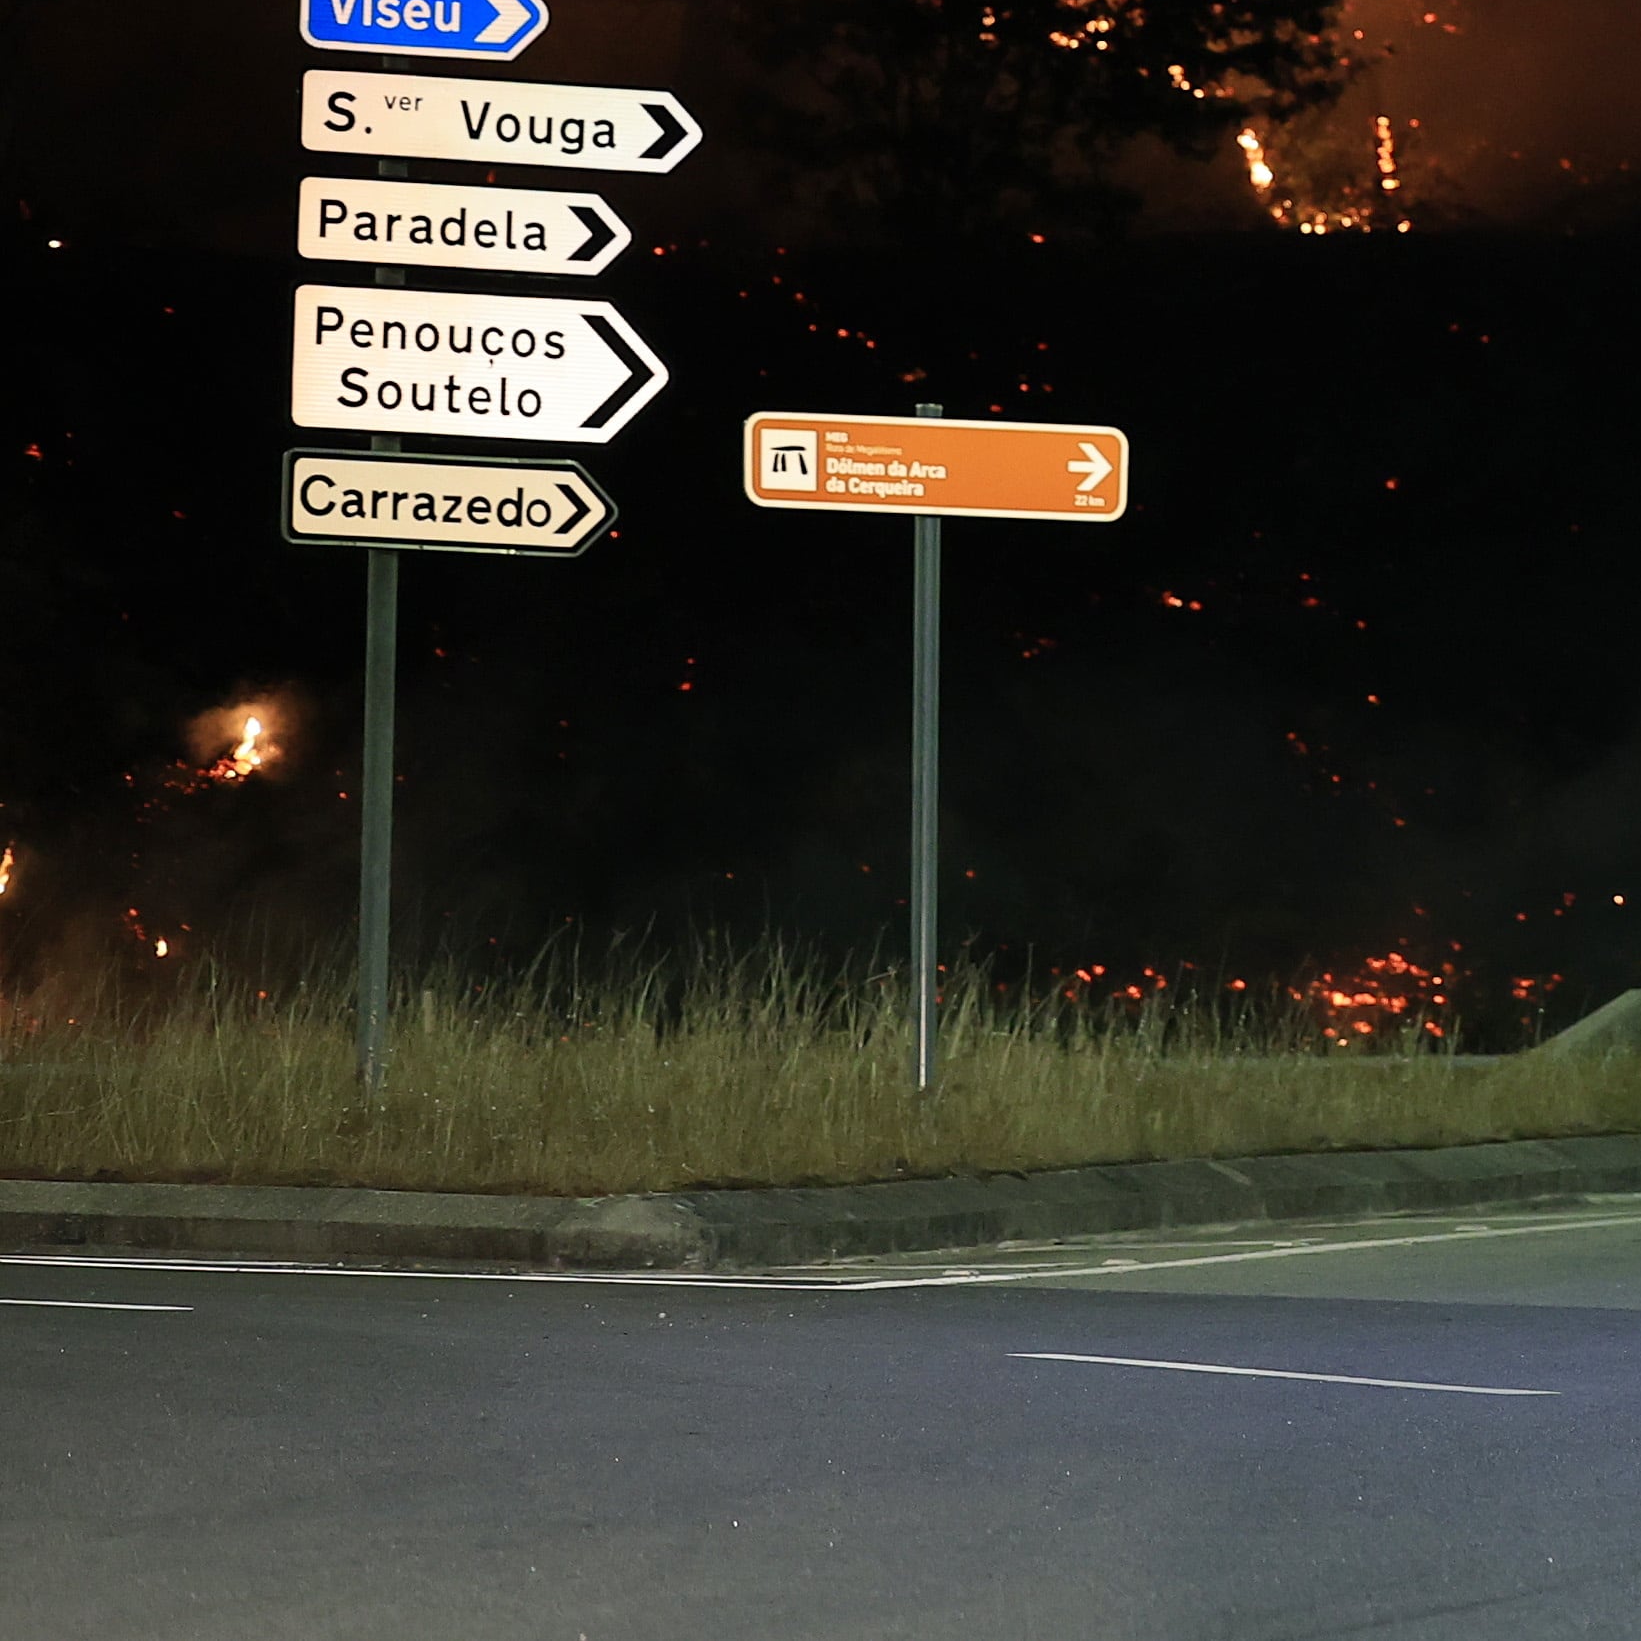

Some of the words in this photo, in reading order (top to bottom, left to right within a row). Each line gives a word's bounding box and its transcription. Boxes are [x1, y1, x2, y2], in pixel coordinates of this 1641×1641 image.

[460, 100, 616, 154] Vouga
[319, 198, 547, 251] Paradela
[315, 305, 565, 367] Penouços
[337, 366, 542, 418] Soutelo
[825, 476, 846, 493] da
[848, 477, 925, 499] Cerqueira
[826, 457, 886, 476] Dólmen
[887, 460, 908, 477] da
[909, 461, 947, 479] Arca
[300, 474, 552, 528] Carrazedo
